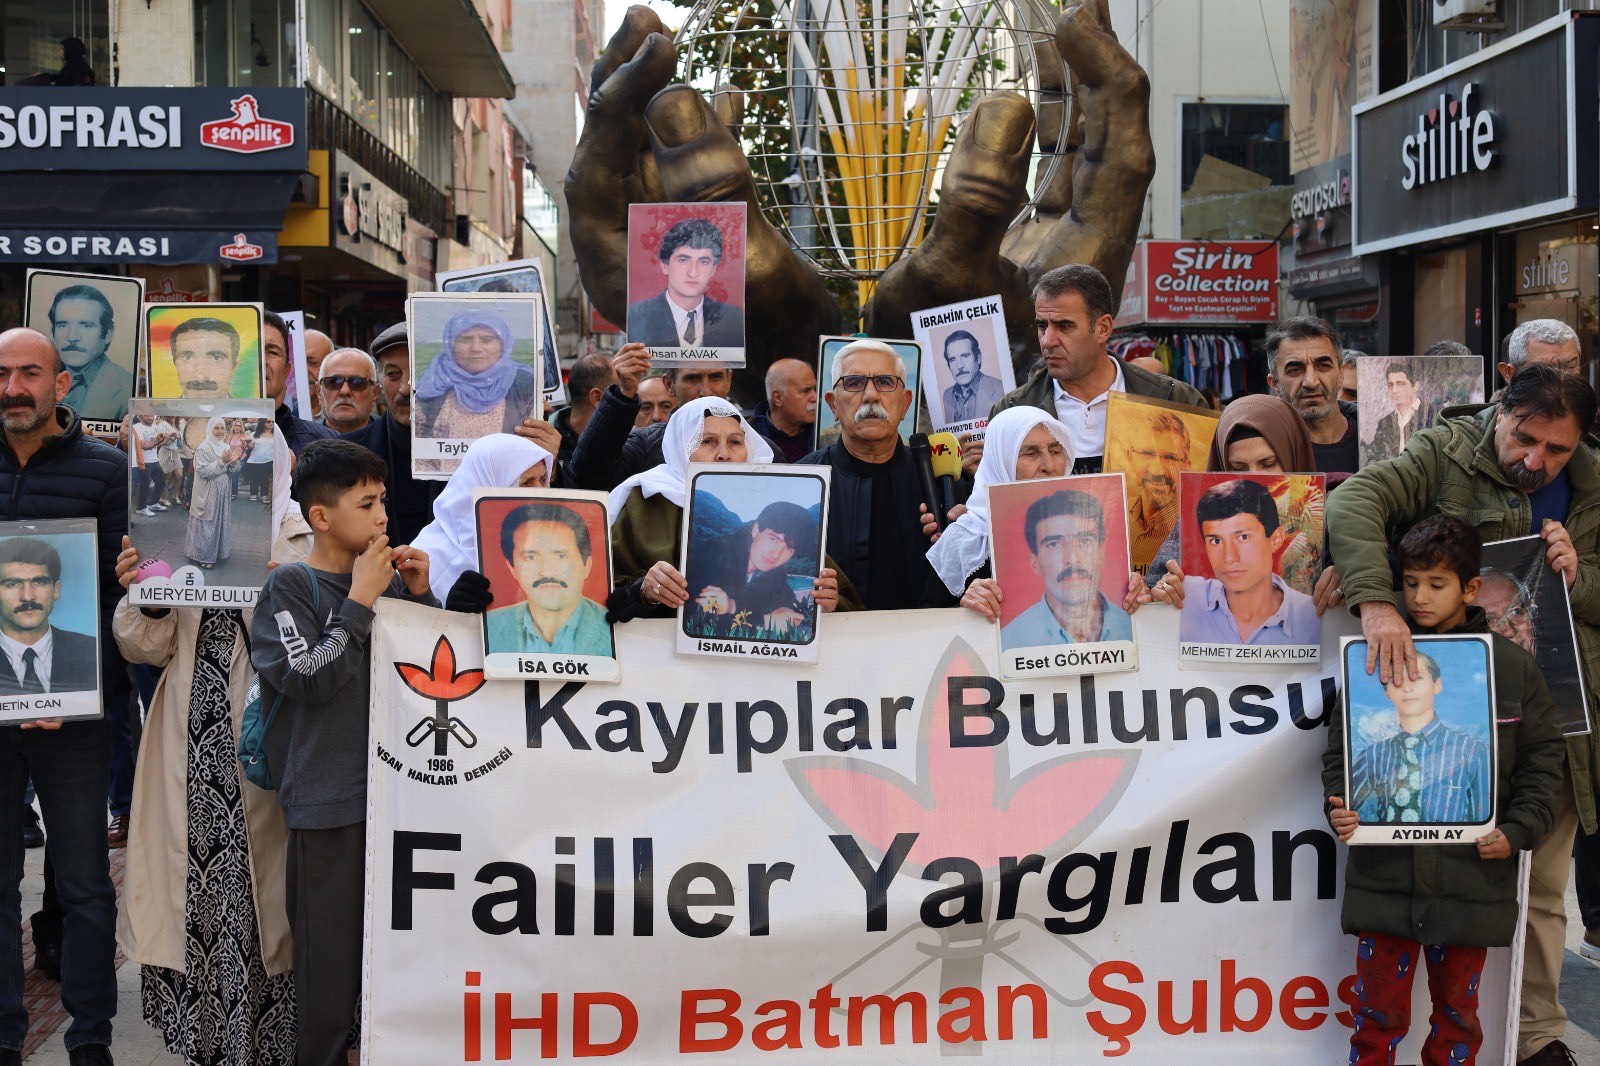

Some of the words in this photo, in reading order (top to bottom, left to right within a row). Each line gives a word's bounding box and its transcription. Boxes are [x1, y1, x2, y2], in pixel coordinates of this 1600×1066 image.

[0, 105, 182, 149] SOFRASI
[211, 122, 283, 145] şenpiliç
[1401, 82, 1494, 191] stilife
[23, 236, 170, 257] SOFRASI
[1172, 246, 1253, 276] Şirin
[1522, 249, 1570, 289] stilife
[1154, 273, 1270, 293] Collection
[919, 309, 964, 329] İBRAHİM
[965, 302, 1000, 321] ÇELİK
[680, 349, 719, 359] KAVAK
[140, 587, 207, 602] MERYEM
[212, 589, 261, 603] BULUT
[697, 640, 747, 655] İSMAİL
[750, 643, 798, 658] AĞAYA
[1015, 656, 1050, 671] Eset
[1054, 649, 1125, 668] GÖKTAYI
[1181, 646, 1233, 658] MEHMET
[1235, 647, 1262, 659] ZEKİ
[1264, 648, 1317, 659] AKYILDIZ
[518, 657, 548, 674] İSA
[552, 659, 590, 676] GÖK
[34, 699, 62, 709] CAN
[524, 679, 915, 774] Kayıplar
[947, 674, 1337, 749] Bulunsu
[407, 768, 458, 786] HAKLARI
[463, 745, 513, 782] DERNEĞİ
[427, 758, 454, 772] 1986
[1391, 829, 1440, 840] AYDIN
[1443, 829, 1464, 840] AY
[391, 829, 796, 939] Failler
[828, 819, 1338, 936] Yargılan
[463, 970, 639, 1062] İHD
[679, 982, 1049, 1054] Batman
